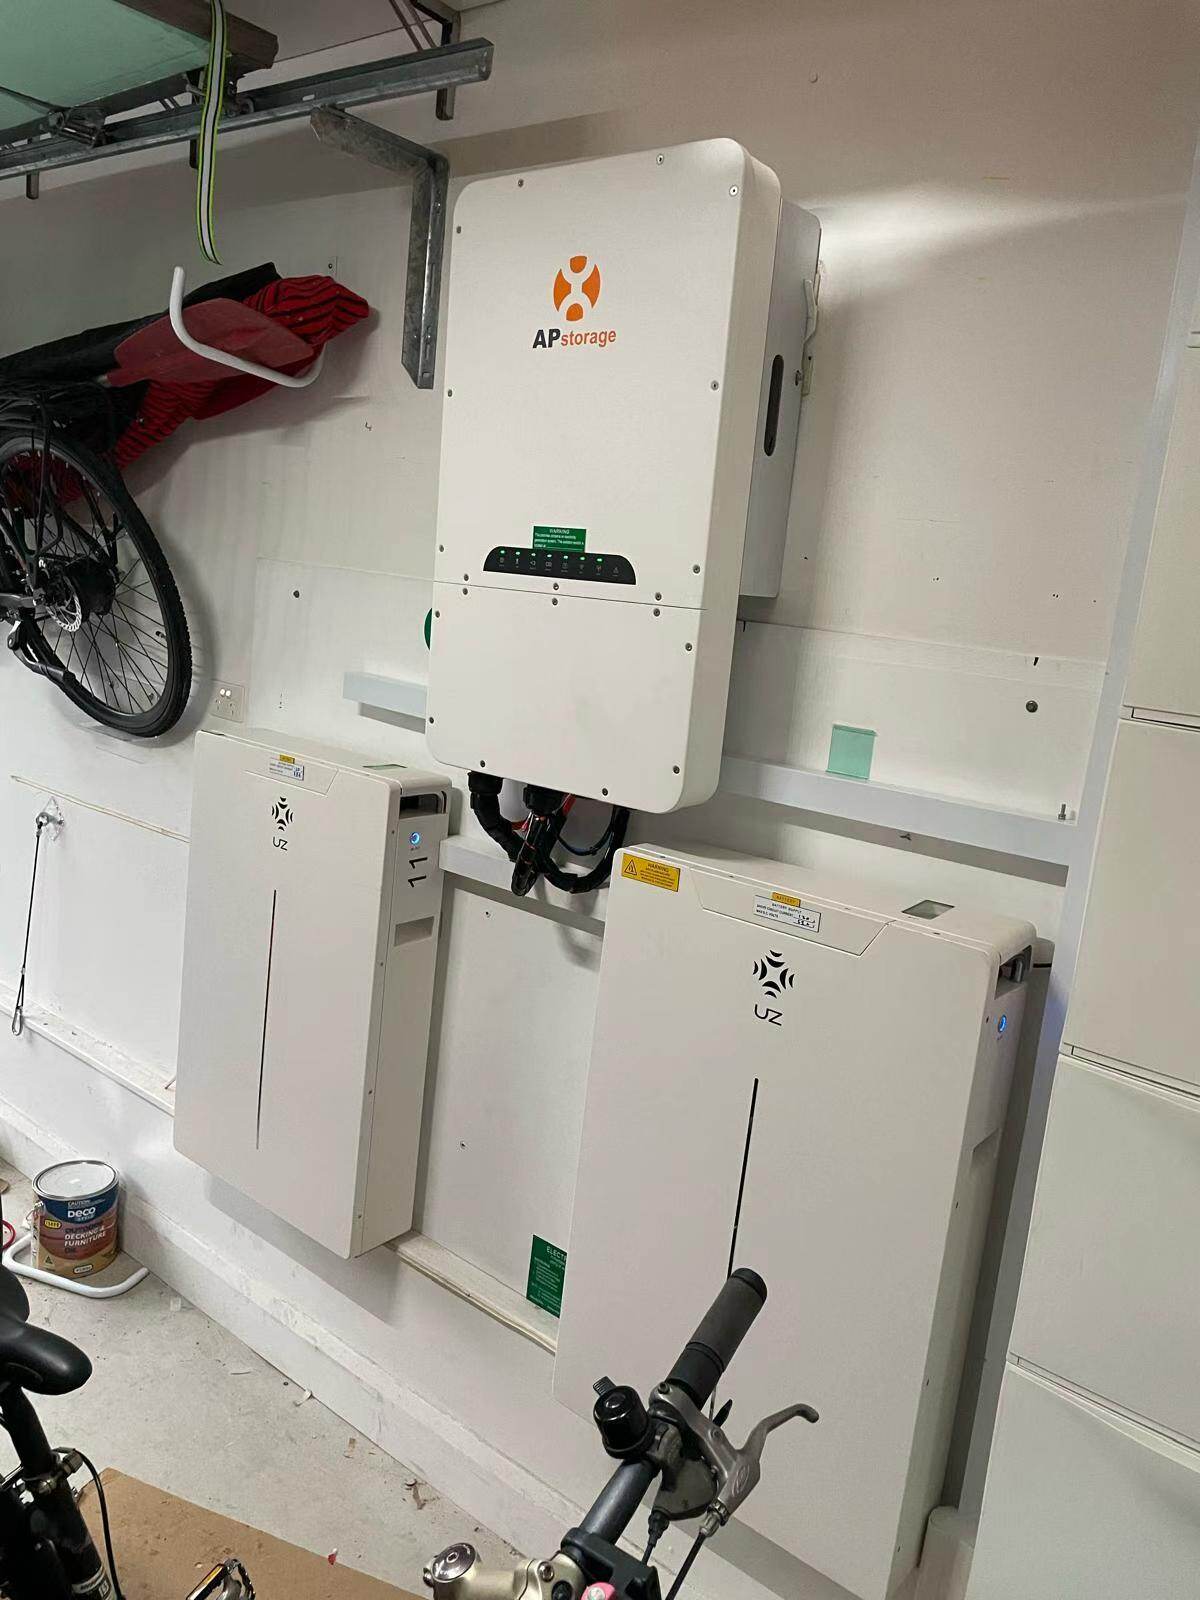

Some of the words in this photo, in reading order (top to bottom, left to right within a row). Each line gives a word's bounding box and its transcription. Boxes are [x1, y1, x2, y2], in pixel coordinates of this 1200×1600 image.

[272, 835, 289, 852] UZ
[754, 1003, 783, 1027] UZ
[64, 1231, 106, 1247] FURNITURE
[65, 1227, 99, 1240] DECKING
